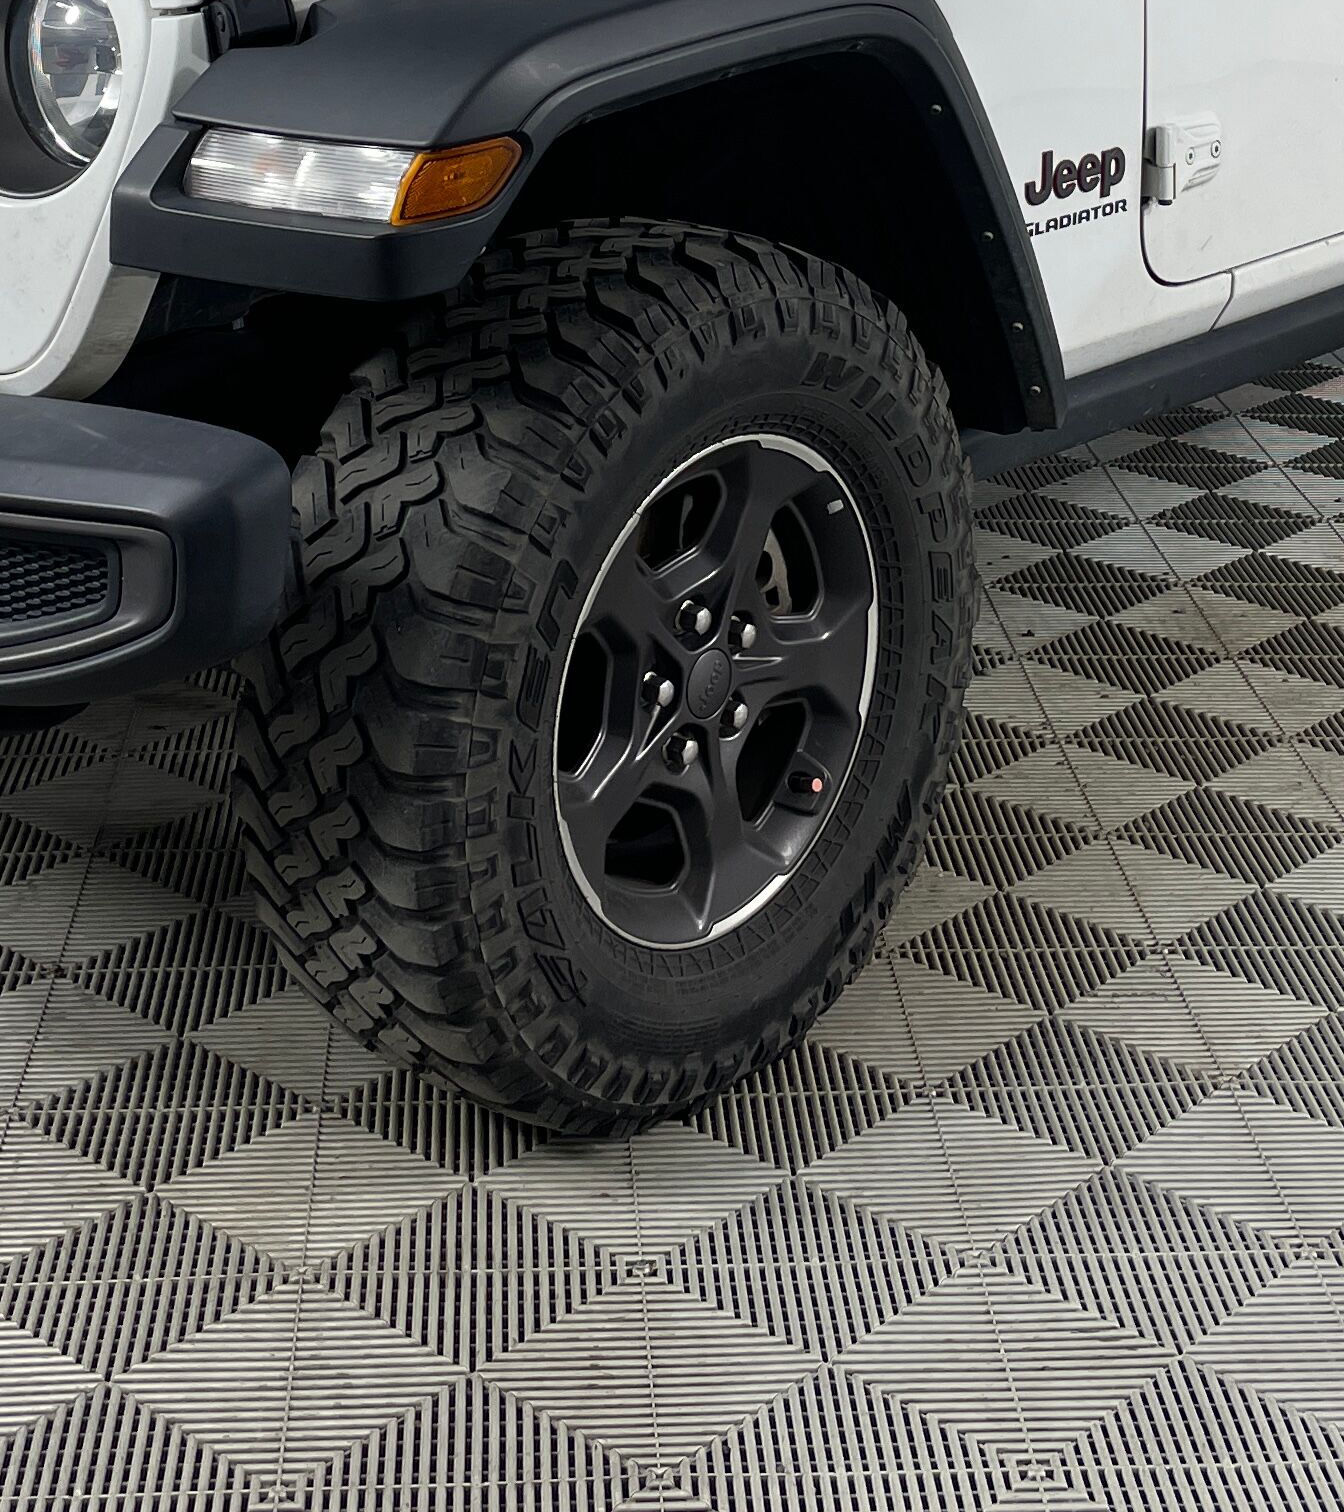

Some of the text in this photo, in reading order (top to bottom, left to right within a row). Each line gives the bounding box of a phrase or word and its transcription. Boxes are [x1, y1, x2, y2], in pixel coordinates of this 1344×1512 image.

[1024, 146, 1126, 206] Jeep
[1025, 198, 1128, 237] GLADIATOR
[800, 350, 956, 745] WILDPEAK
[506, 558, 587, 1007] FALKEN
